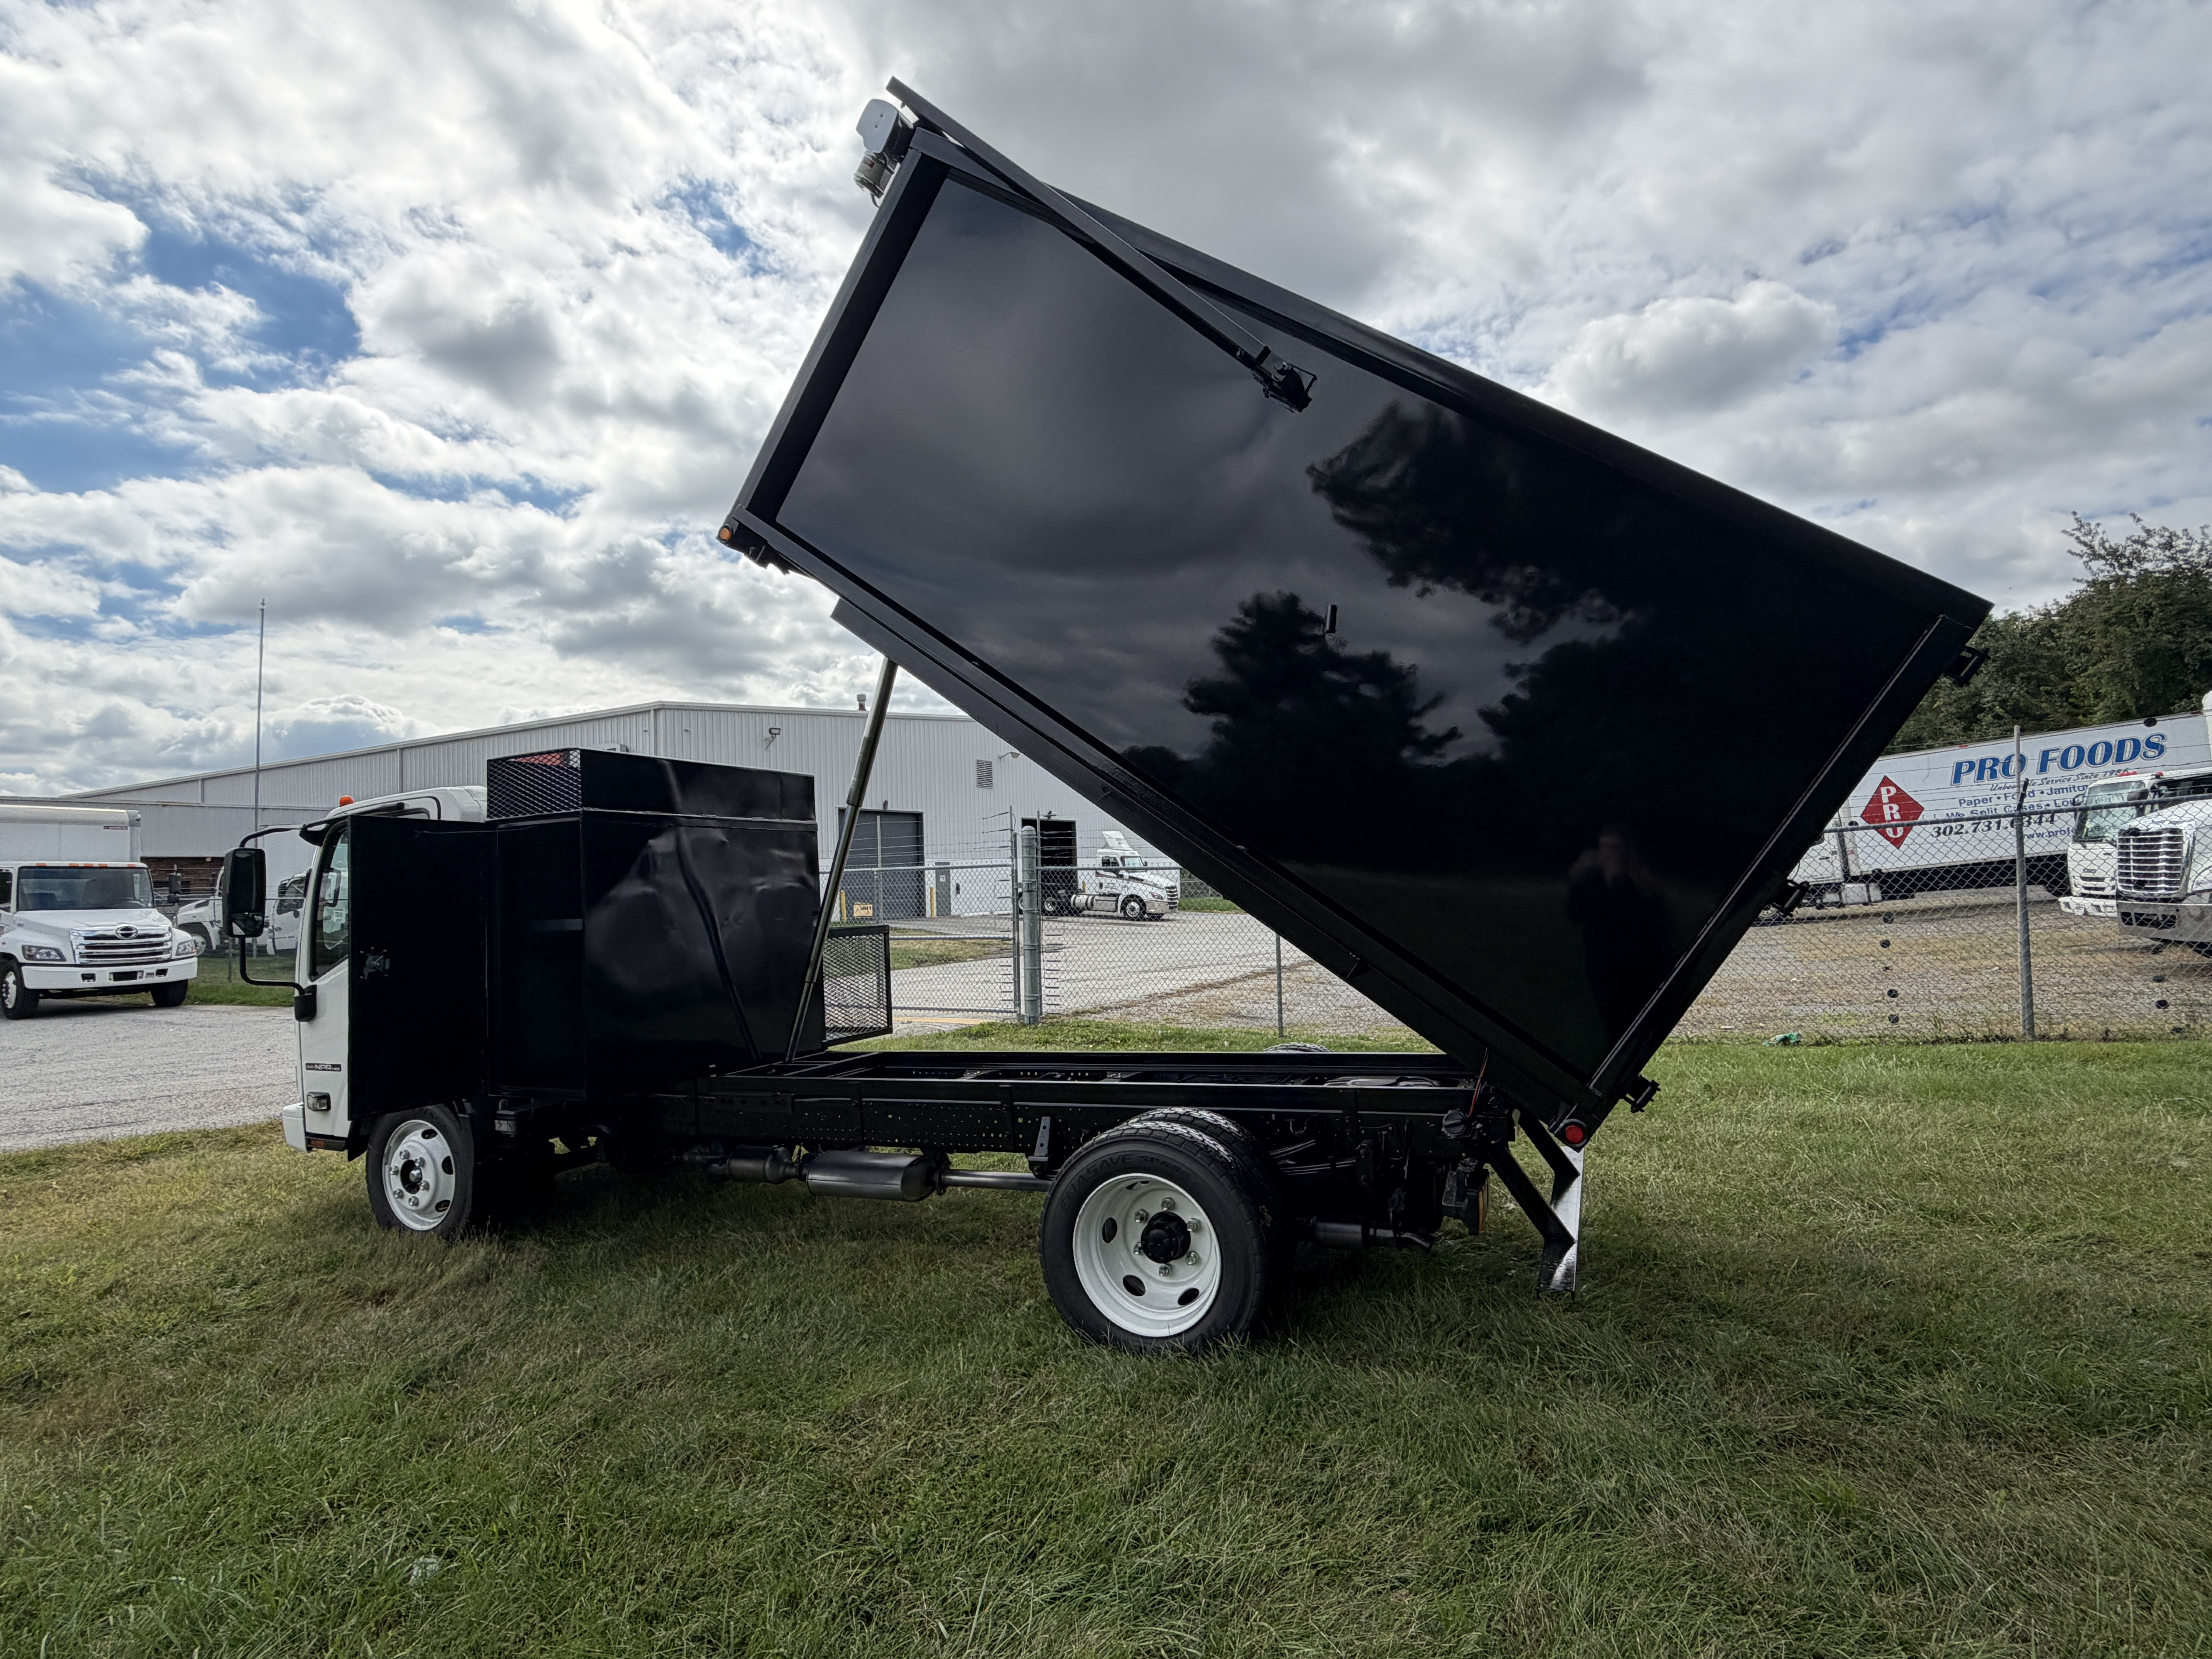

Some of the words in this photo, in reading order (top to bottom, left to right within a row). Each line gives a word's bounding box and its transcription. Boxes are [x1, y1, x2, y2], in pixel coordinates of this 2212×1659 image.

[1952, 753, 2027, 785] PRO
[2037, 732, 2167, 774] FOODS
[2038, 777, 2071, 785] Service
[2073, 772, 2099, 781] Since
[1881, 786, 1905, 838] PRO
[1958, 796, 1993, 807] Paper
[2004, 789, 2035, 801] Fod
